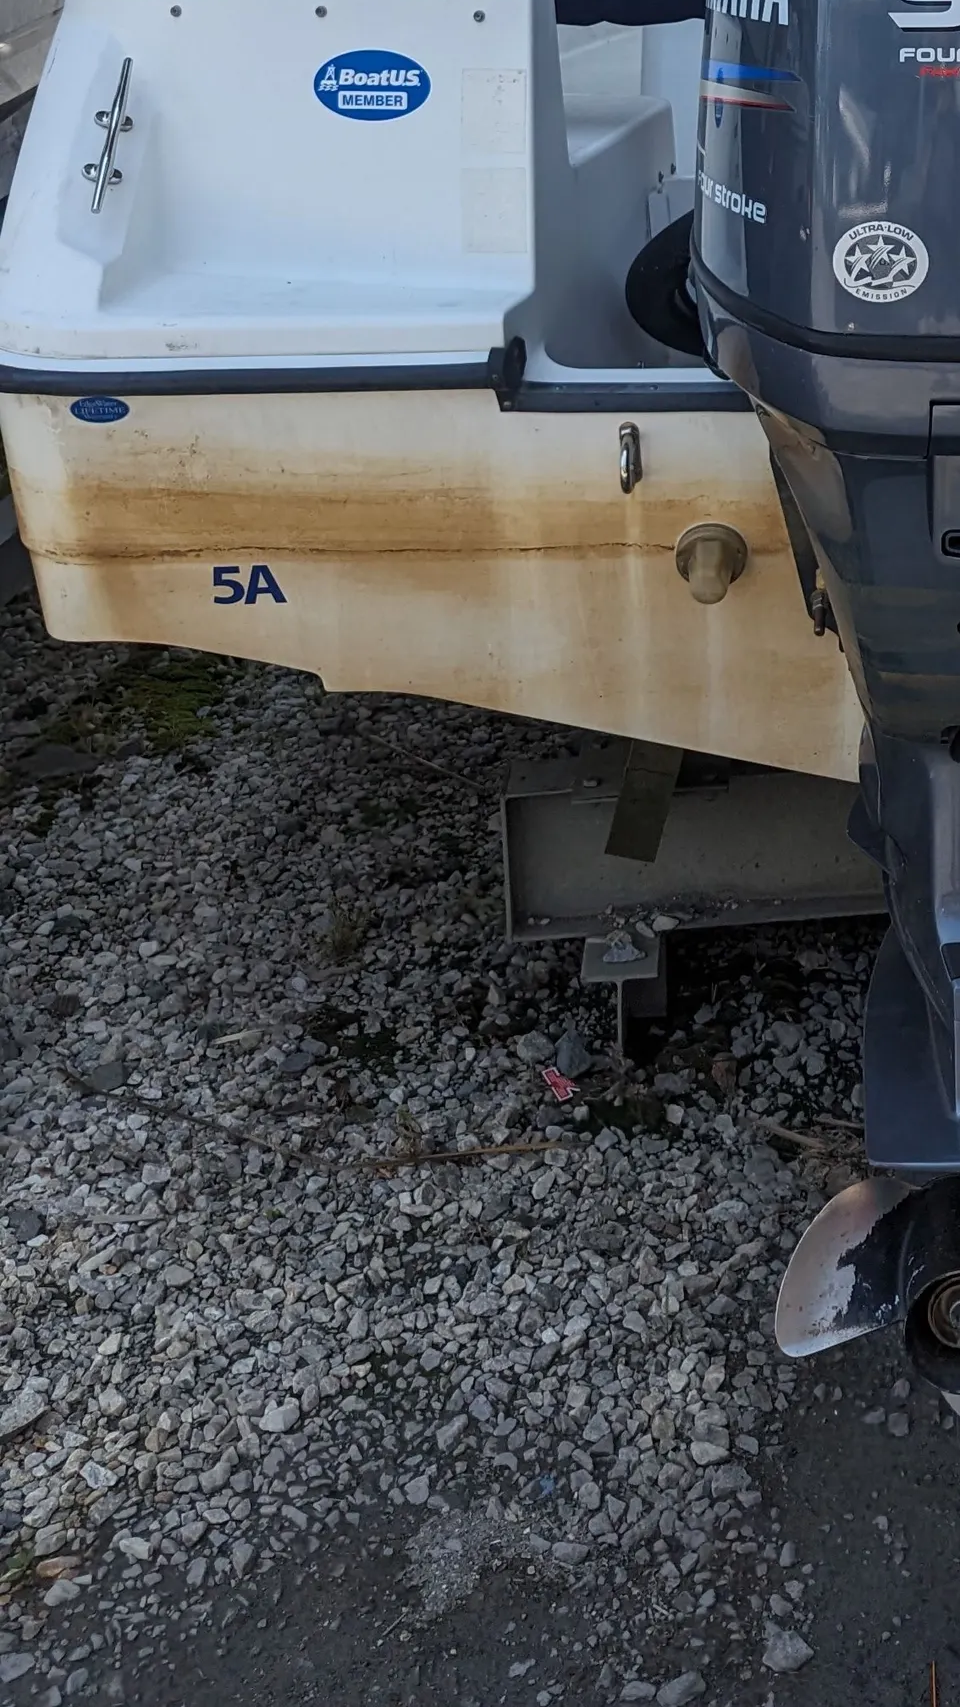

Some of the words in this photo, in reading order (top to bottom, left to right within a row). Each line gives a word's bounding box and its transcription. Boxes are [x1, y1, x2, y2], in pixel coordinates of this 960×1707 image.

[342, 94, 404, 107] MEMBER
[855, 287, 908, 301] EMISSION
[213, 564, 288, 605] 5A
